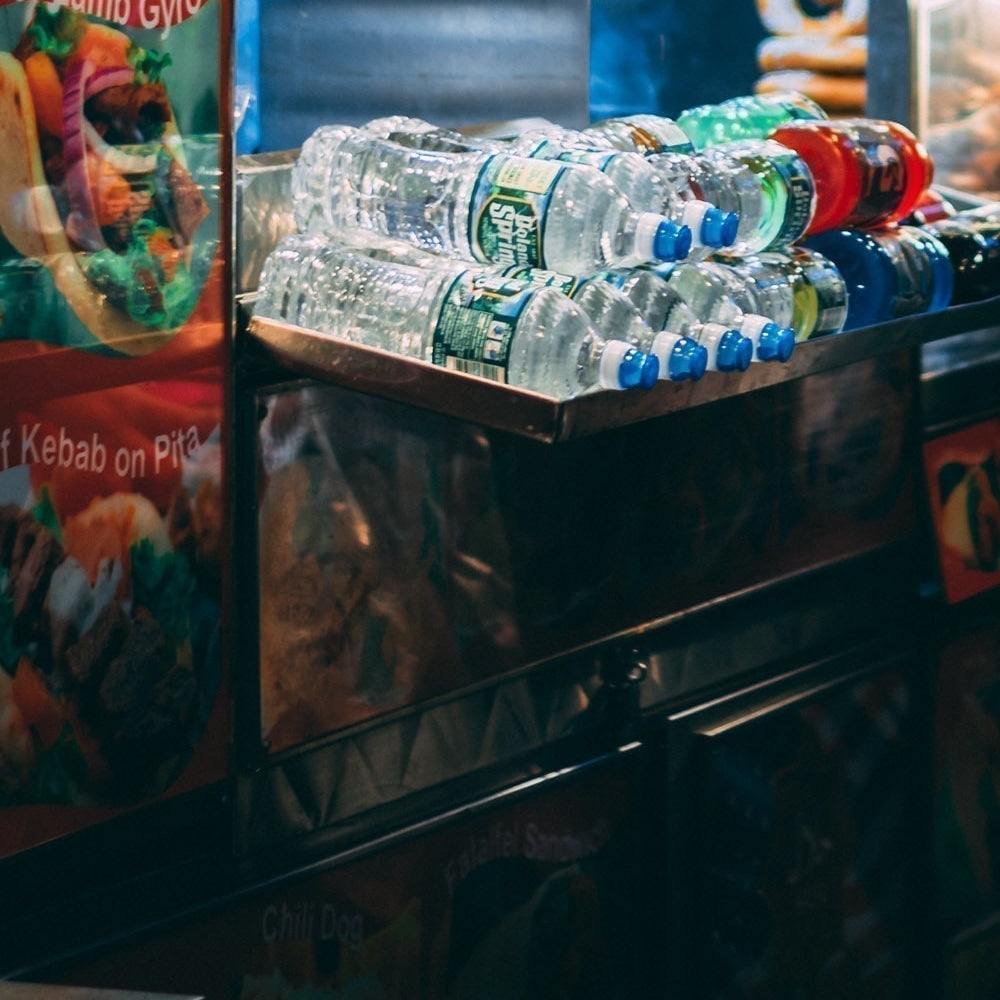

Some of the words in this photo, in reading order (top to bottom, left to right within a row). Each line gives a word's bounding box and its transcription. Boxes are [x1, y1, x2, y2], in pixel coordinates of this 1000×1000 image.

[21, 422, 107, 474] Kebab
[114, 446, 146, 479] on
[153, 424, 201, 476] Pita
[262, 902, 314, 943] Chili
[320, 903, 363, 951] Dog
